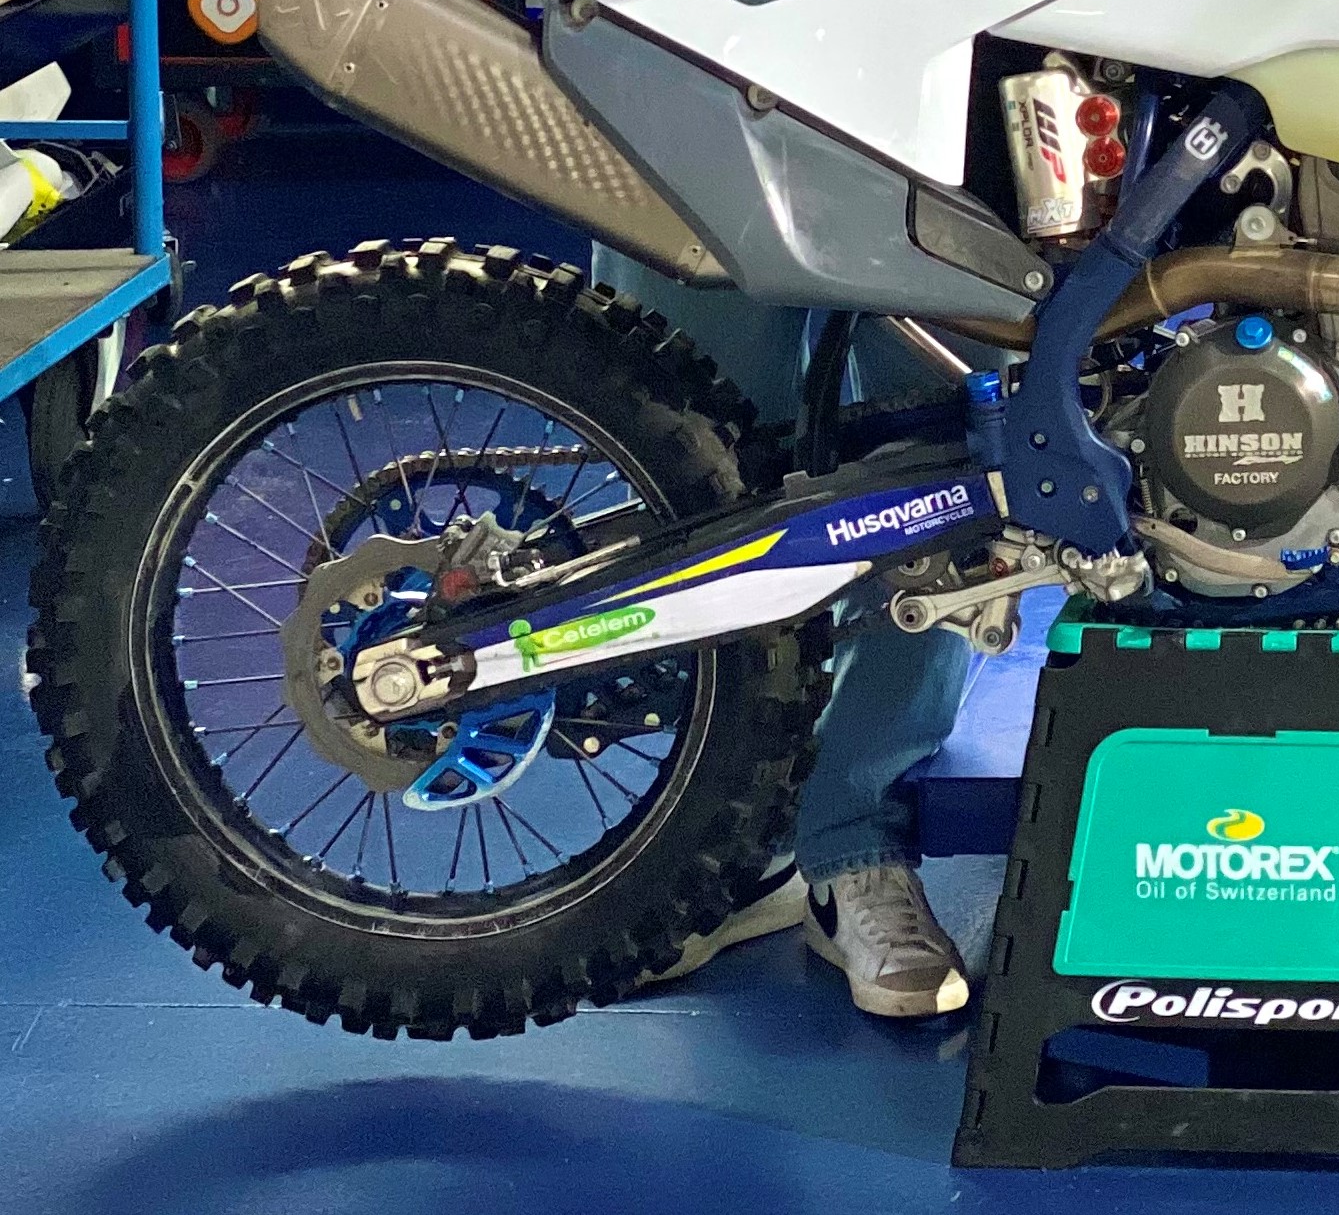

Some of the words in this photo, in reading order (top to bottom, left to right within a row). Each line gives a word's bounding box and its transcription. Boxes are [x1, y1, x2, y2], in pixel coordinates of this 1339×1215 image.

[1217, 384, 1265, 422] H
[1184, 432, 1303, 453] HINSON
[1214, 471, 1279, 485] FACTORY
[826, 484, 970, 546] Husqvarna
[904, 506, 975, 536] MOTORCYCLES
[543, 611, 647, 648] Cetelem
[1135, 843, 1336, 881] MOTOREX
[1136, 881, 1165, 899] Oil
[1175, 883, 1197, 900] of
[1206, 882, 1336, 903] Switzerland
